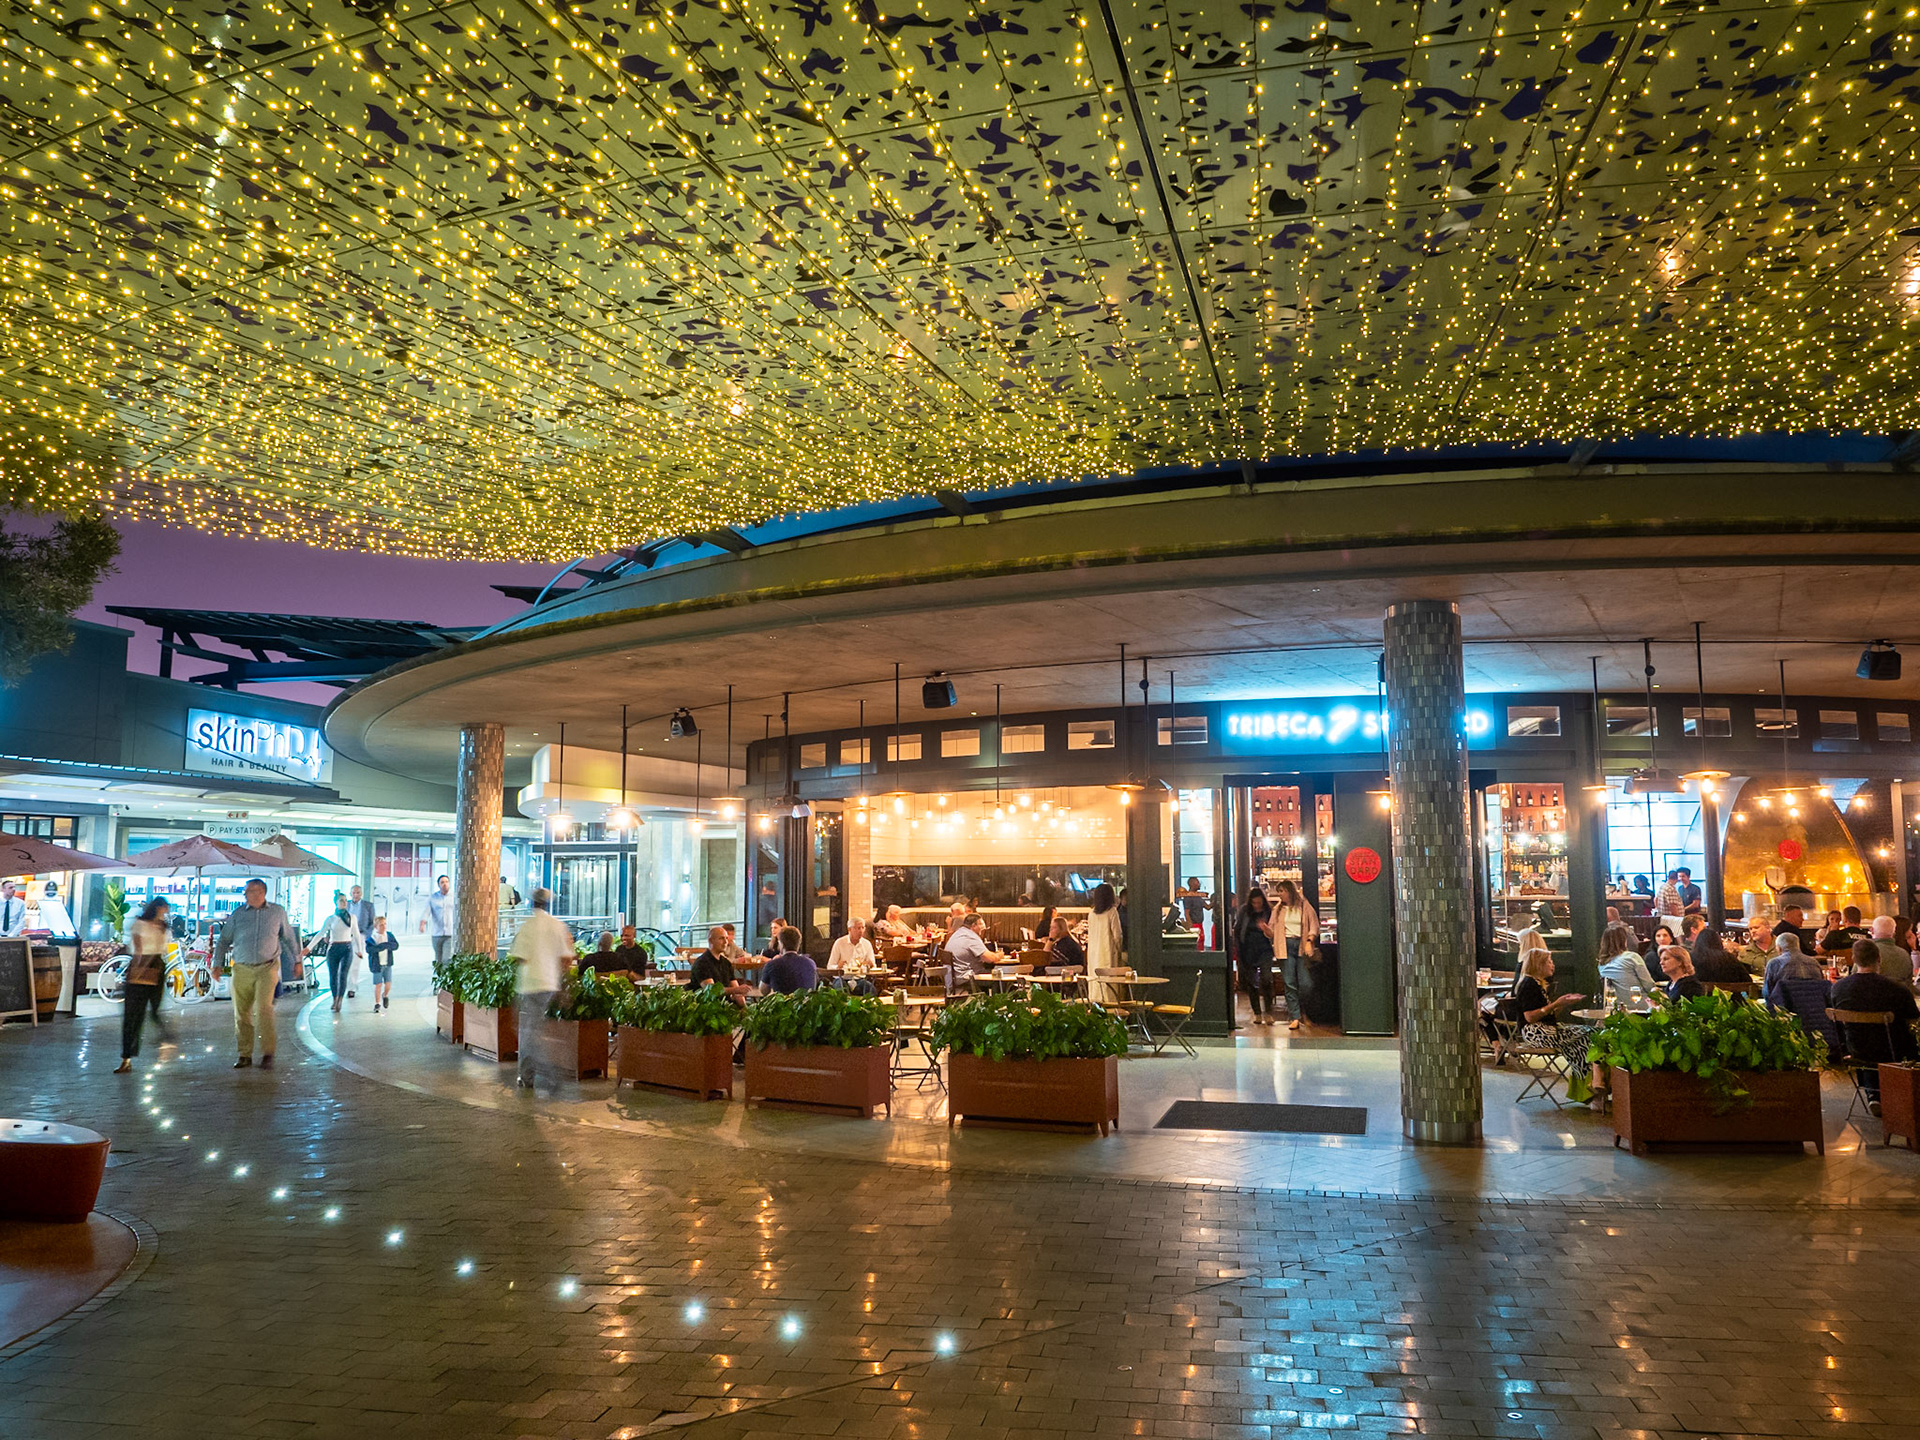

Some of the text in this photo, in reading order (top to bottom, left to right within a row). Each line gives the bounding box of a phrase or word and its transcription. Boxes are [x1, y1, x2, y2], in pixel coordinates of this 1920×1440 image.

[1228, 714, 1323, 736] TRIBECA
[211, 757, 234, 767] HAIR
[249, 762, 287, 772] BEAUTY
[219, 826, 233, 834] PAY
[235, 826, 266, 835] STATION
